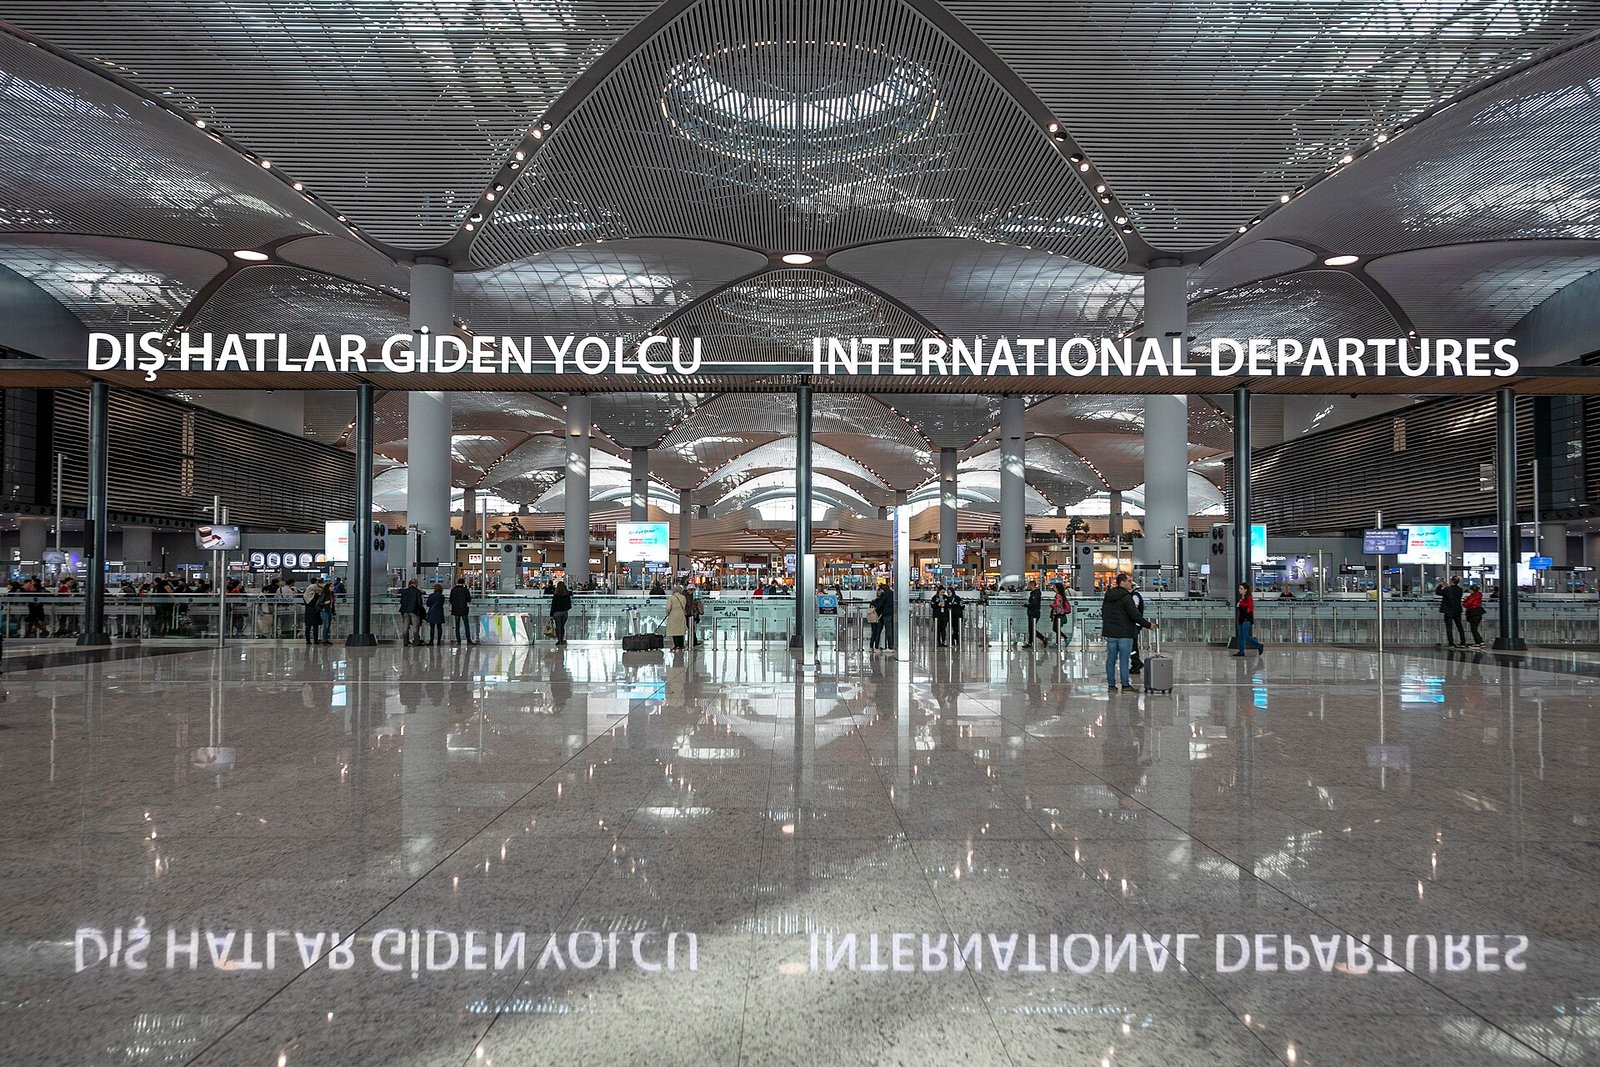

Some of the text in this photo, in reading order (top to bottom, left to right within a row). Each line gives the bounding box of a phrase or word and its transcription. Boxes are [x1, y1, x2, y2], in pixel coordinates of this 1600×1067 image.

[88, 325, 702, 381] DIŞ HATLAR GİDEN YOLCU
[812, 337, 1519, 377] INTERNATIONAL DEPARTURES
